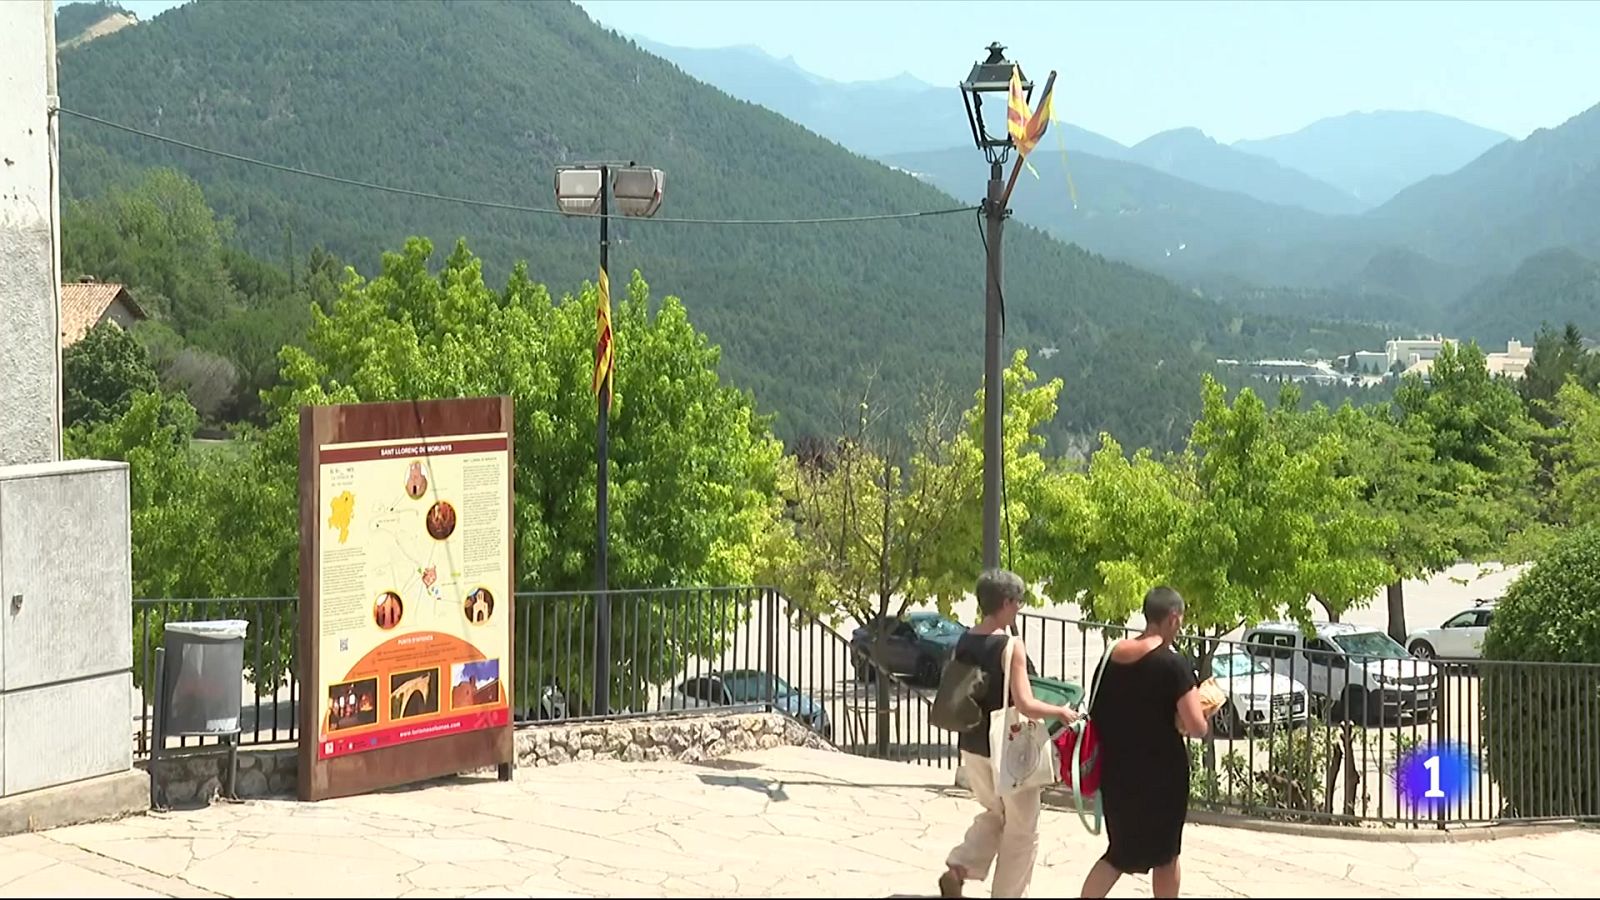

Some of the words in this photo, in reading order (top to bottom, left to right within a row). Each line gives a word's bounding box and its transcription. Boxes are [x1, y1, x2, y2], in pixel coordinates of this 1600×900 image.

[381, 448, 394, 456] SANT
[395, 446, 418, 455] LLORENÇ
[427, 444, 452, 452] MORUNYS
